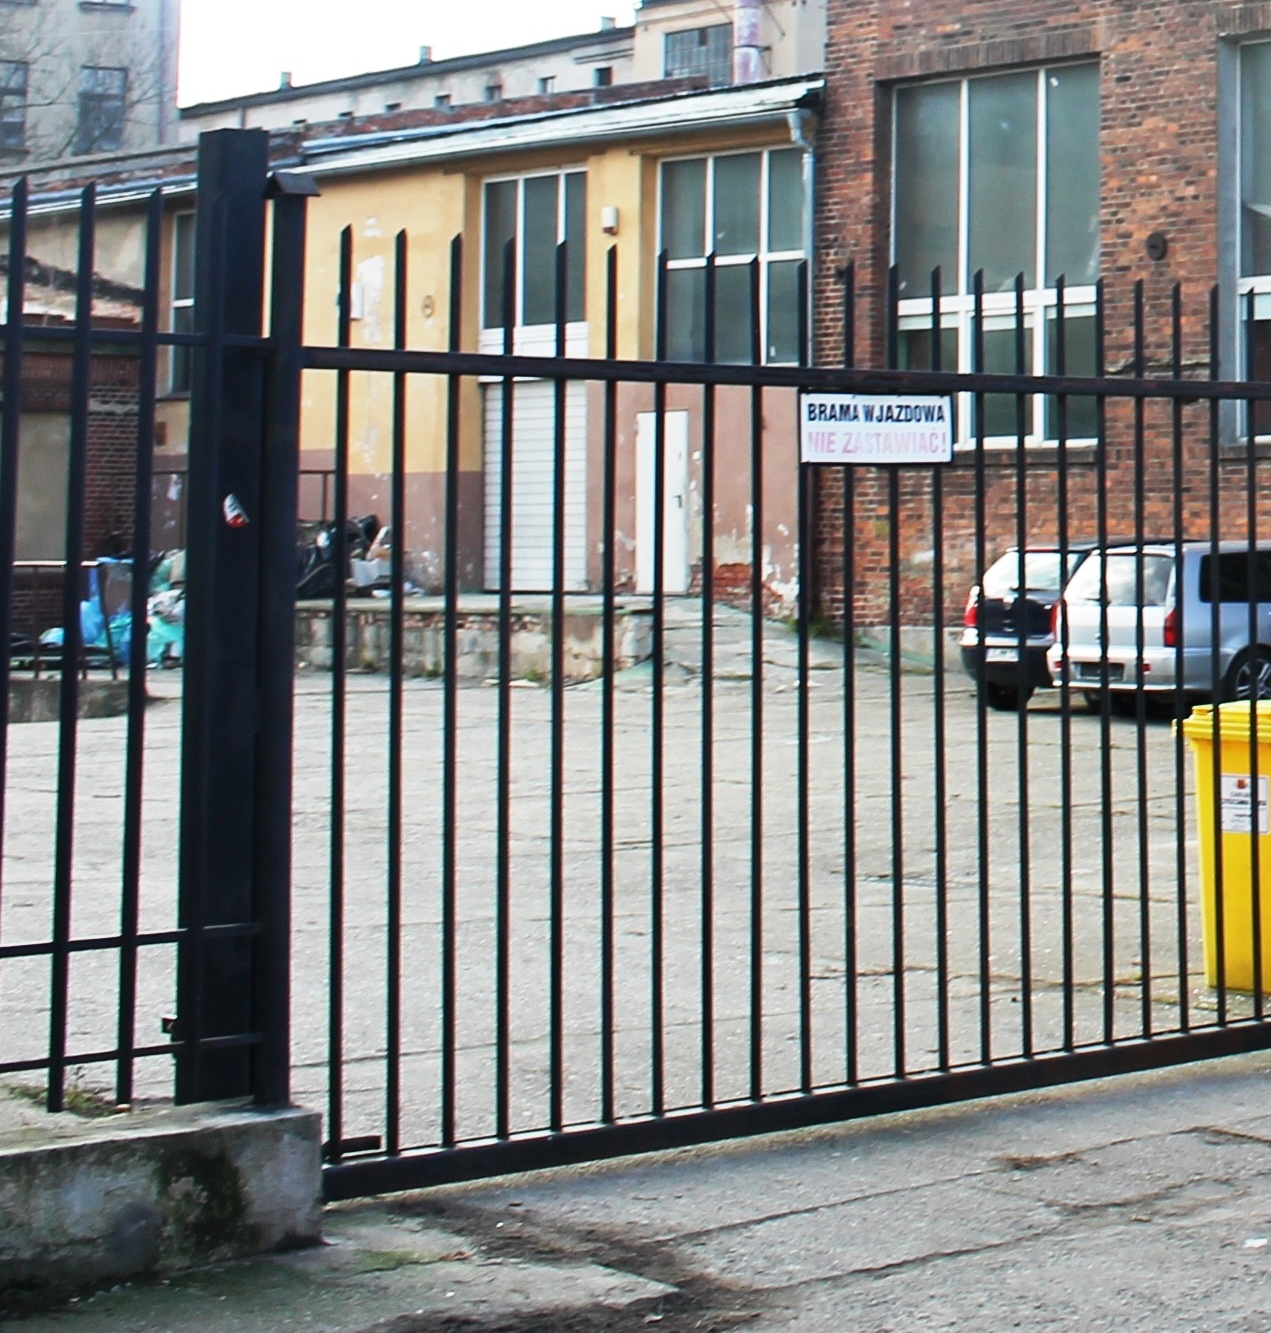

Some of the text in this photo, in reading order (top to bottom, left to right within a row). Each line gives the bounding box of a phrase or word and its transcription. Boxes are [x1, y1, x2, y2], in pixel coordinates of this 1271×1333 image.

[807, 402, 945, 422] BRAMA WJAZDOWA
[807, 426, 947, 453] NIE ZASTAWIAĆ!
